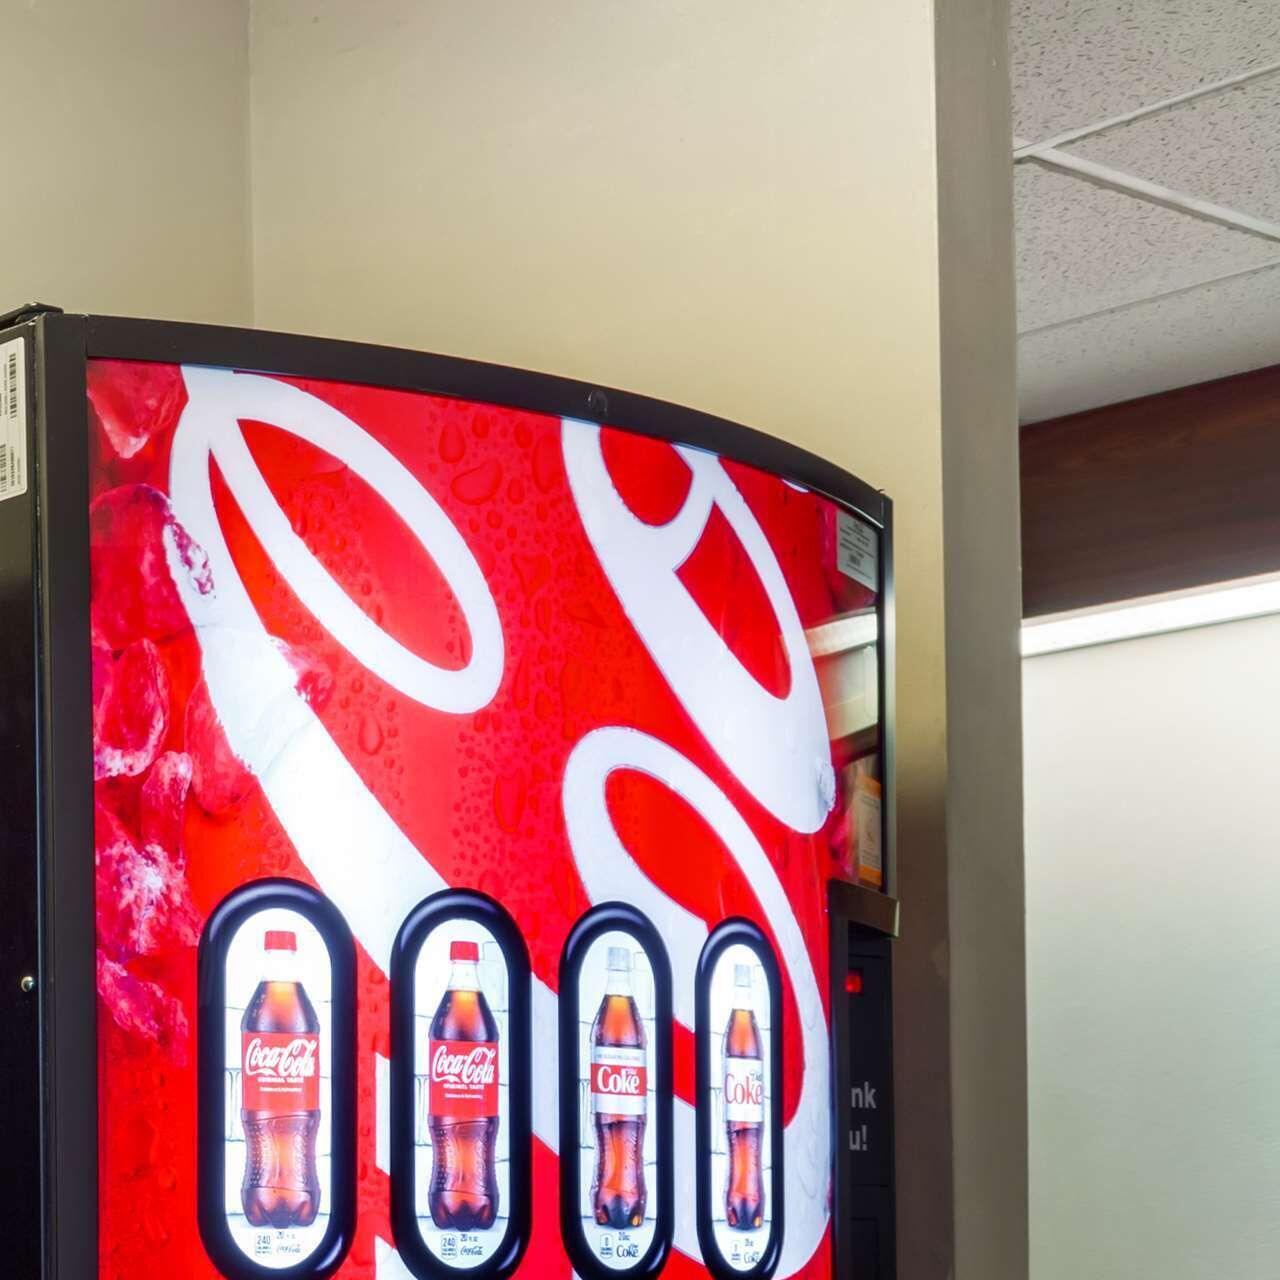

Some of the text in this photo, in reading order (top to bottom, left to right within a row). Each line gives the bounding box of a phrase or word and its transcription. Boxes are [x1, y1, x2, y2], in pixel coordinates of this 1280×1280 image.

[246, 1038, 317, 1076] Coca-Cola
[432, 1045, 496, 1083] Coca-Cola
[597, 1066, 640, 1094] Coke
[725, 1072, 762, 1105] Coke
